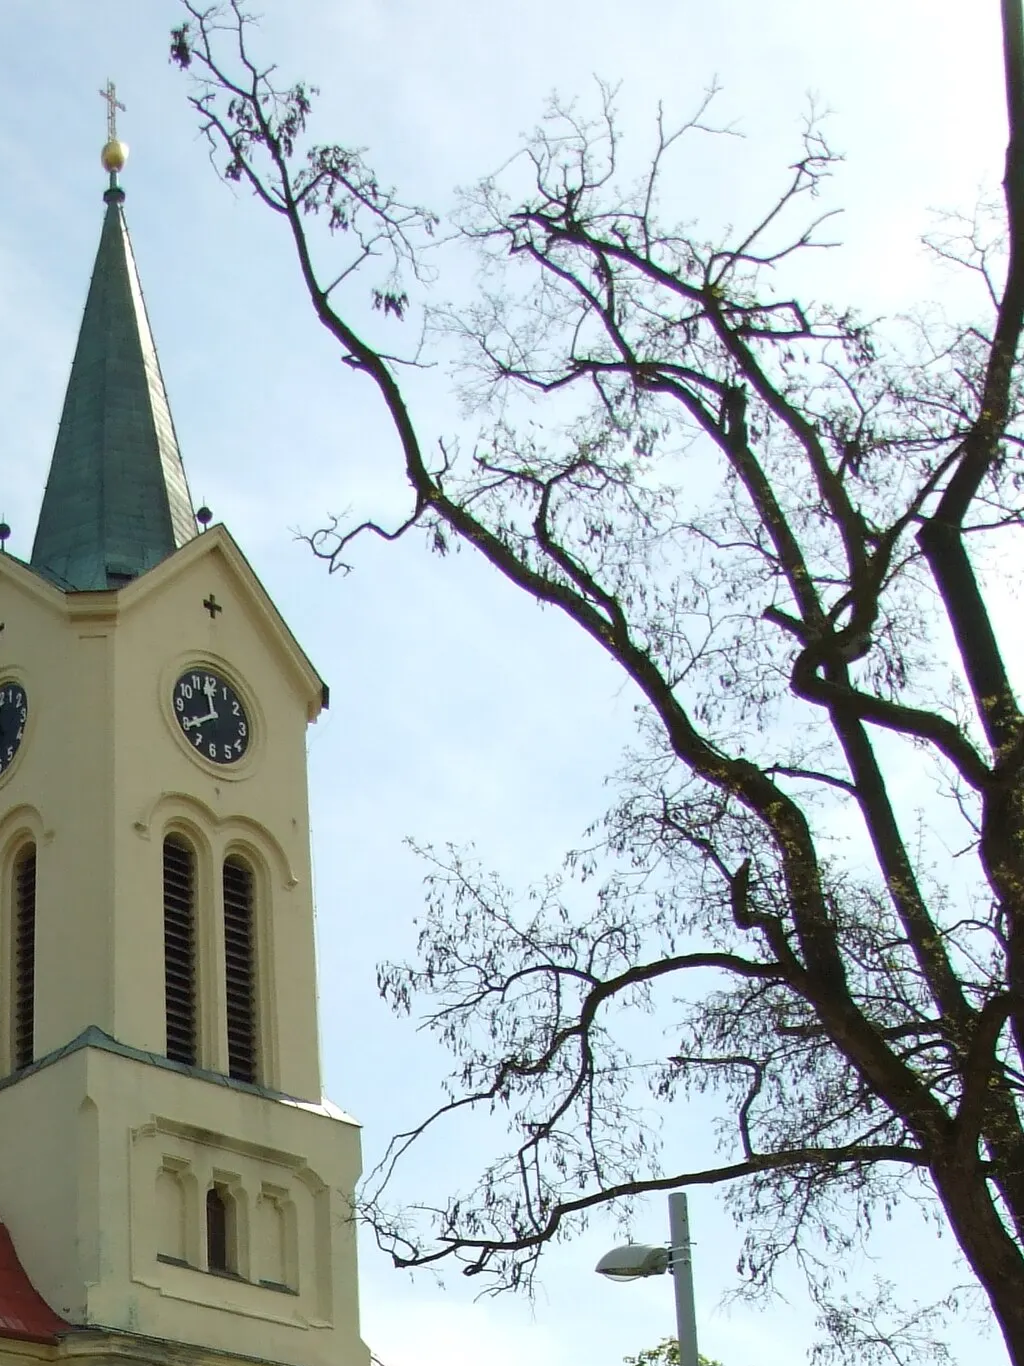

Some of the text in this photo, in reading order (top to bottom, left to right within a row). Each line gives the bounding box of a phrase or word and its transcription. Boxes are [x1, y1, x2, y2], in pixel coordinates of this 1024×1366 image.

[192, 675, 201, 690] 11
[9, 690, 12, 703] 1
[180, 683, 192, 698] 10
[222, 687, 227, 700] 1
[16, 693, 22, 708] 2
[177, 698, 184, 711] 9
[20, 708, 26, 722] 3
[232, 702, 240, 716] 2
[16, 727, 22, 740] 4
[239, 722, 246, 736] 3
[195, 733, 202, 745] 7
[234, 740, 242, 752] 4
[7, 746, 13, 761] 5
[209, 744, 216, 757] 6
[224, 745, 231, 759] 5
